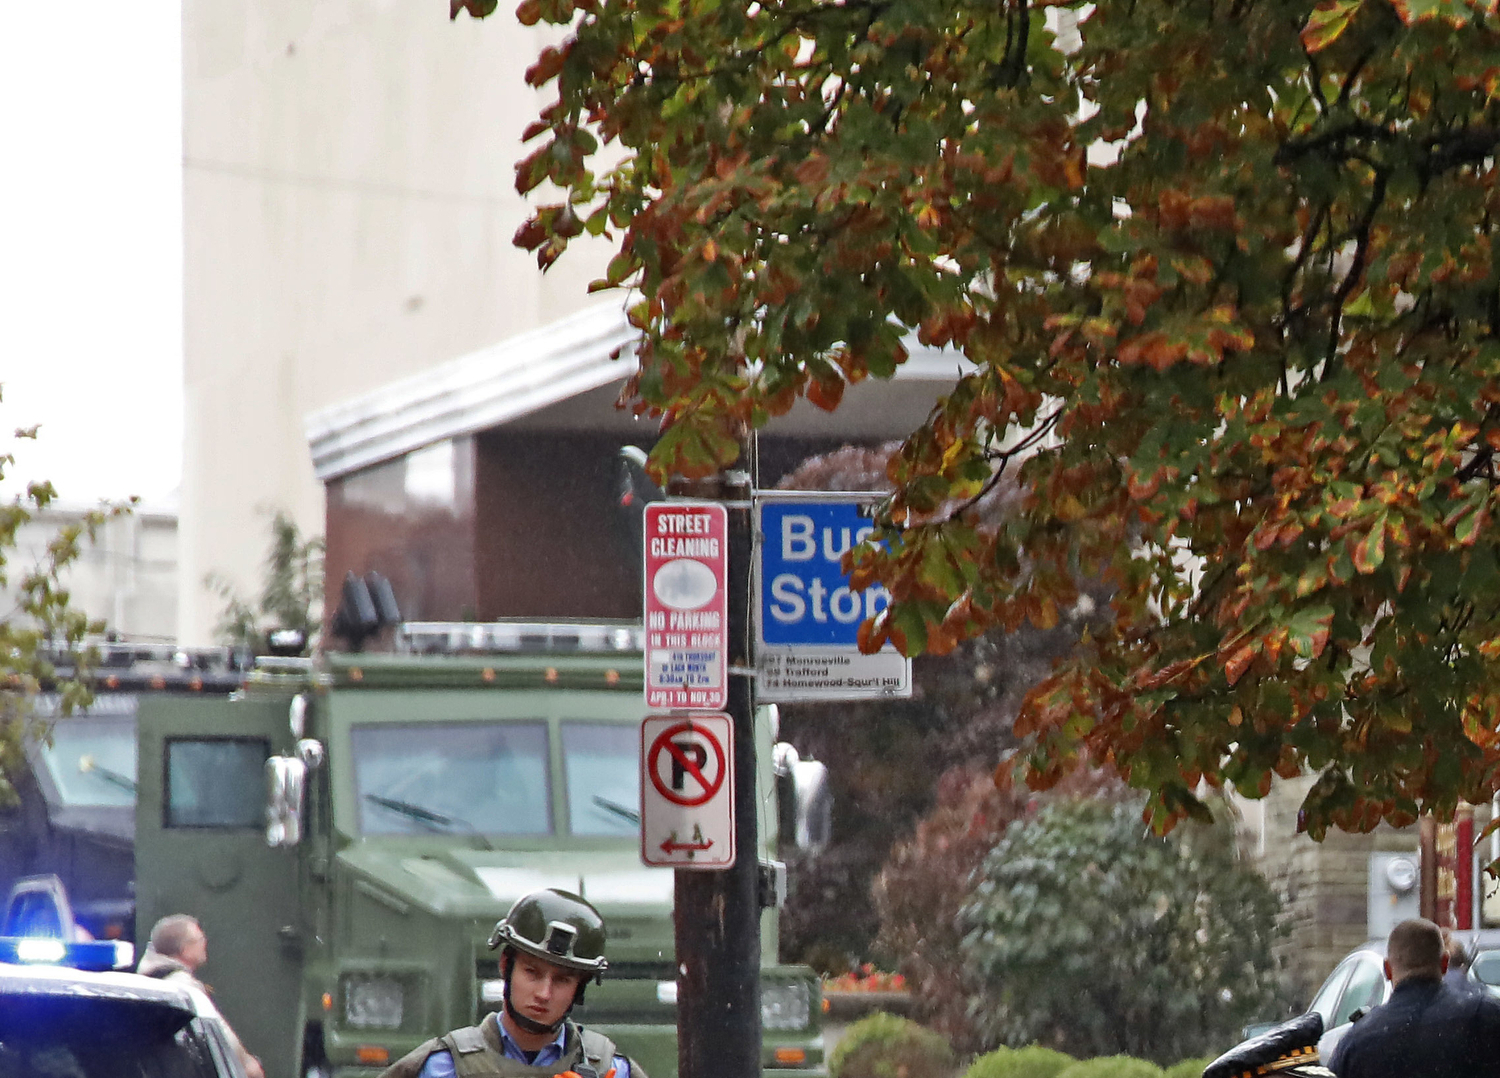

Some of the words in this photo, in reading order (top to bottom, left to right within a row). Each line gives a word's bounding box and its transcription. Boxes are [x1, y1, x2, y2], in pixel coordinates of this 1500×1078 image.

[658, 514, 711, 533] STREET
[651, 537, 719, 557] CLEANING
[649, 611, 666, 631] NO
[670, 611, 720, 631] PARKING
[651, 633, 661, 648] IN
[666, 633, 687, 648] THIS
[691, 633, 720, 648] BLOCK
[883, 678, 899, 686] Hill
[677, 691, 687, 703] TO
